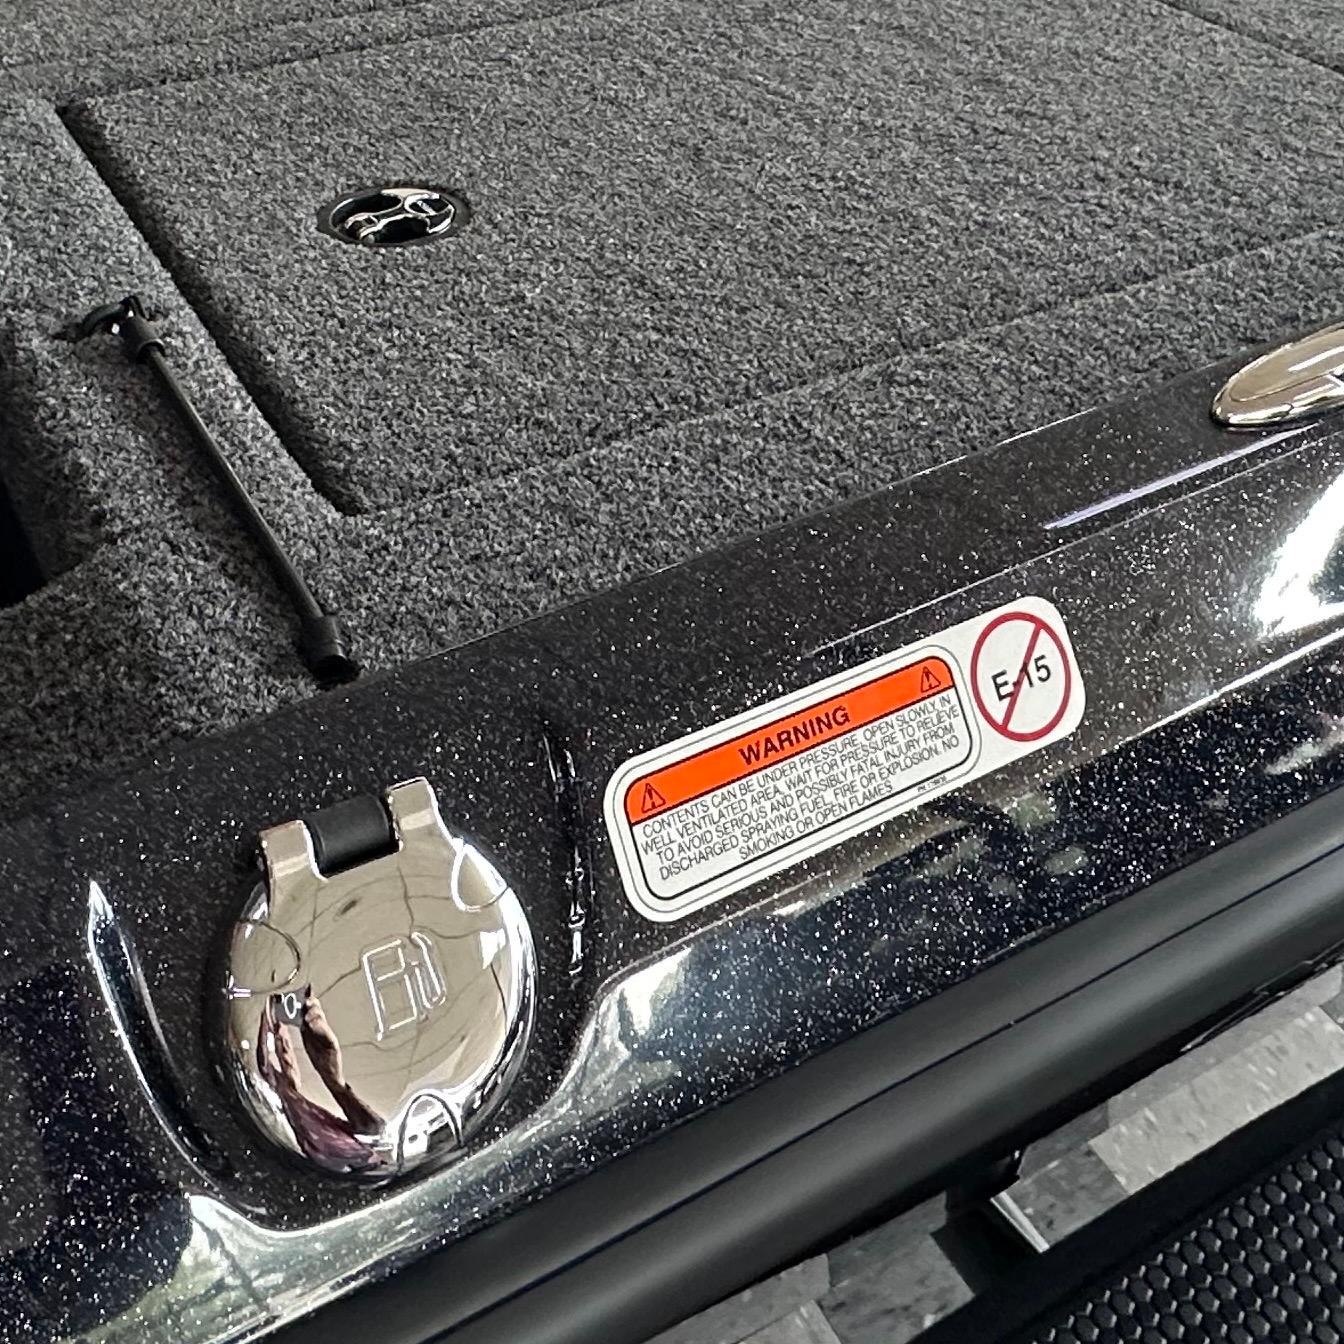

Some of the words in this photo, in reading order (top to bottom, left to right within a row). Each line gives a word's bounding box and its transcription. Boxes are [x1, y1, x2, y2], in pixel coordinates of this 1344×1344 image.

[641, 831, 677, 856] WELL
[676, 798, 748, 839] VENTILATED
[785, 769, 813, 791] WAIT
[815, 758, 839, 777] FOR
[840, 731, 899, 766] PRESSURE
[899, 724, 916, 739] TO
[916, 704, 960, 733] RELIEVE
[642, 799, 709, 838] CONTENTS
[711, 788, 737, 808] CAN
[738, 777, 756, 796] BE
[757, 761, 798, 788] UNDER
[862, 719, 895, 742] OPEN
[938, 693, 952, 708] IN
[656, 847, 675, 865] TO
[677, 829, 714, 857] AVOID
[715, 805, 768, 838] SERIOUS
[770, 794, 794, 814] AND
[795, 768, 848, 801] POSSIBLY
[849, 754, 884, 776] FATAL
[884, 737, 921, 763] INJURY
[922, 722, 955, 745] FROM
[737, 704, 851, 766] WARNING
[659, 834, 739, 881] DISCHARGED
[740, 807, 798, 843] SPRAYING
[833, 780, 859, 801] FIRE
[859, 772, 877, 789] OR
[941, 734, 960, 752] NO
[738, 824, 795, 860] SMOKING
[796, 816, 814, 834] OR
[815, 801, 848, 824] OPEN
[848, 778, 893, 806] FLAMES
